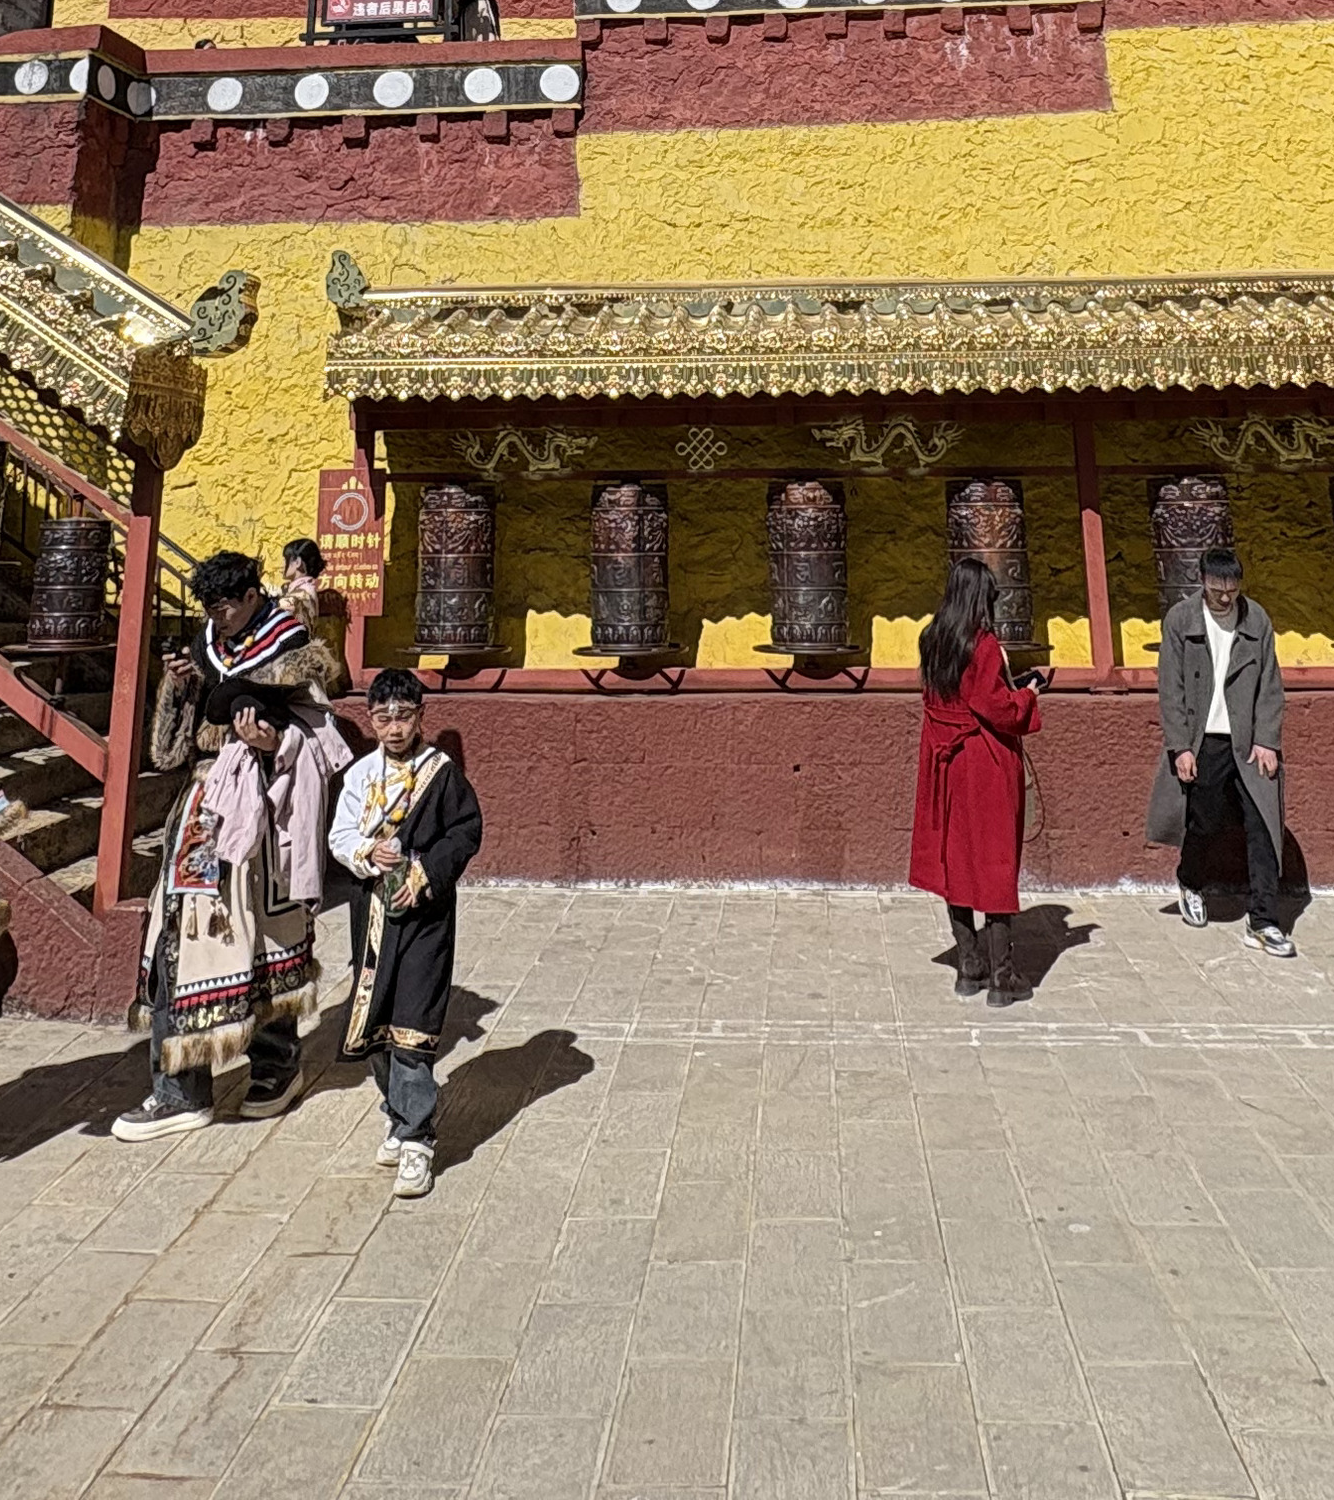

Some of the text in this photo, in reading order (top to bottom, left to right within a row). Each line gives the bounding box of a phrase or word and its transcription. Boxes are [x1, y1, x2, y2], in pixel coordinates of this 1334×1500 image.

[353, 0, 431, 17] 违者后果自负
[319, 532, 381, 549] 请顺时针
[317, 572, 379, 590] 方向转动
